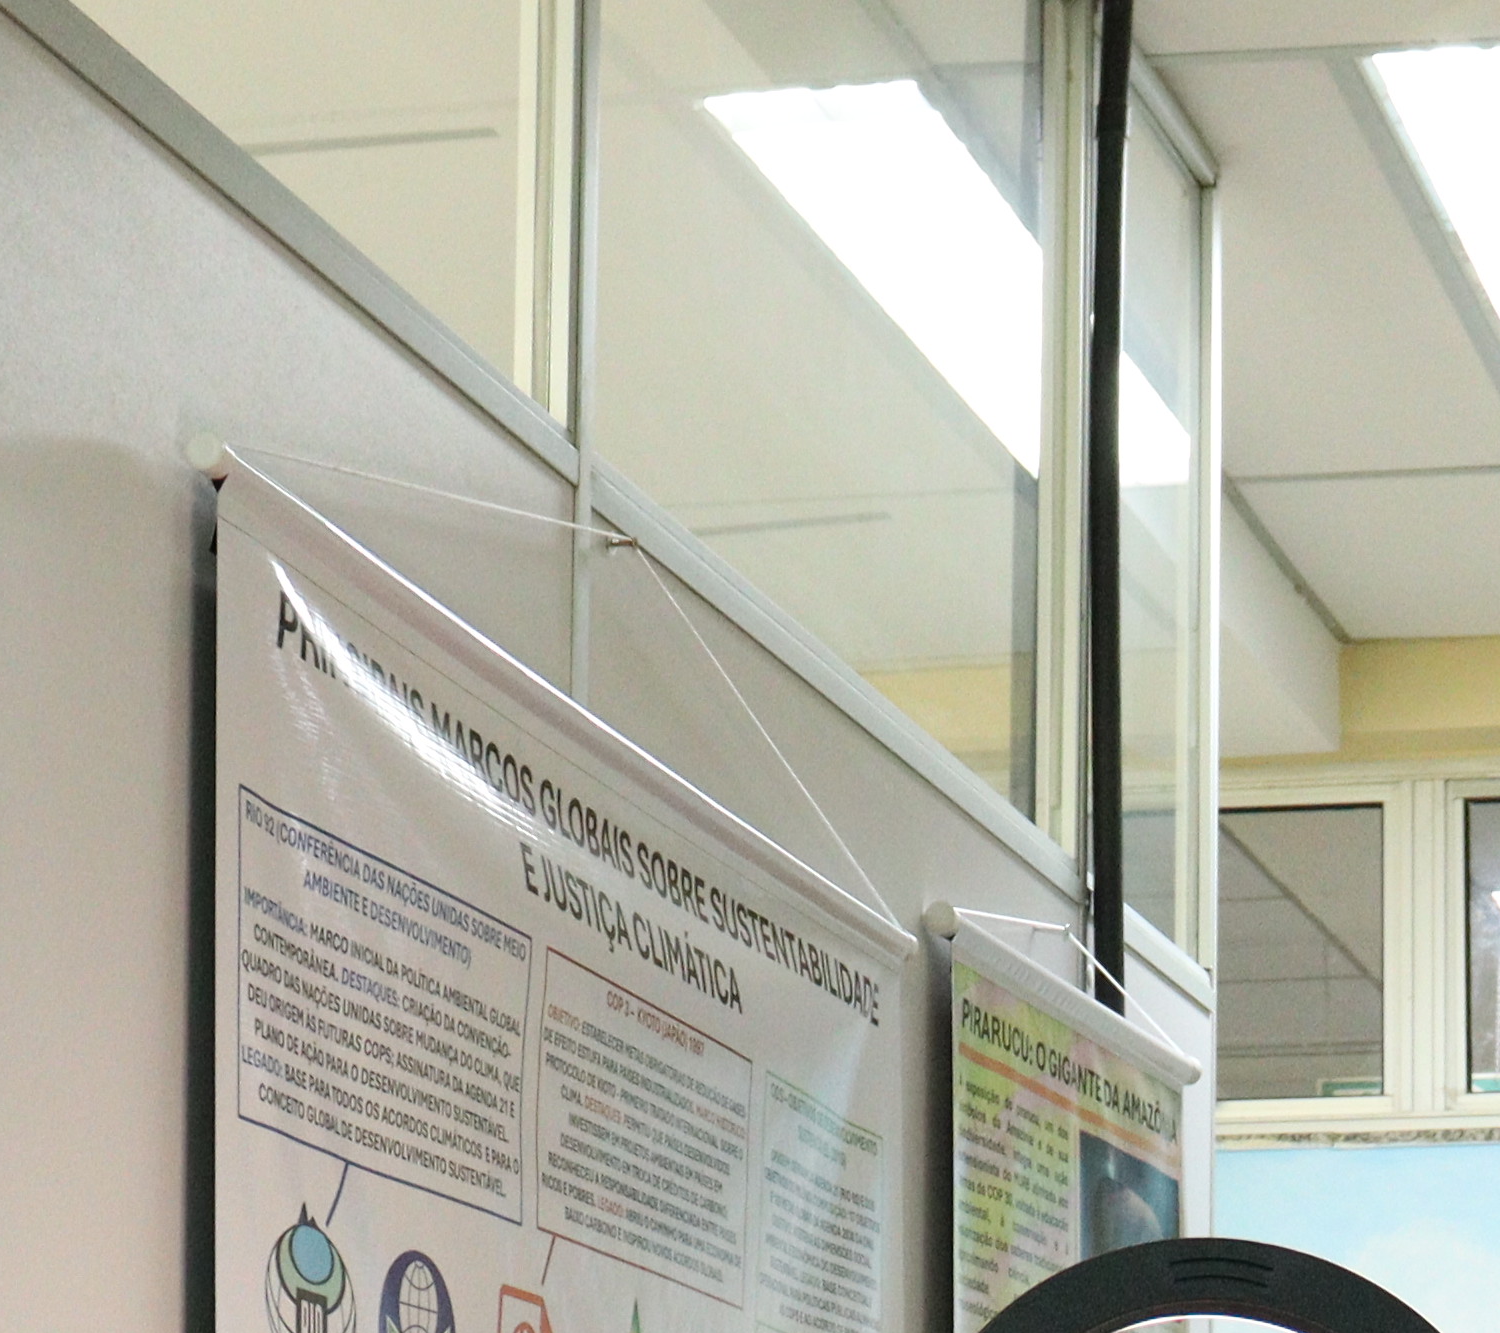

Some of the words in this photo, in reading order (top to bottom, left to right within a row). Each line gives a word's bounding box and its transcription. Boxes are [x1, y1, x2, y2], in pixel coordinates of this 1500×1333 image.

[245, 799, 264, 829] RIO
[265, 811, 274, 835] 92
[275, 817, 360, 879] (CONFERÊNCIA
[362, 860, 384, 890] DAS
[386, 872, 429, 914] NAÇÕES
[431, 896, 469, 933] UNIDAS
[471, 916, 501, 949] SOBRE
[503, 933, 525, 962] MEIO
[303, 867, 360, 914] AMBIENTE
[362, 896, 369, 918] E
[371, 899, 471, 969] DESENVOLVIMENTO)
[430, 701, 536, 818] MARCOS
[539, 774, 634, 880] GLOBAIS
[637, 838, 708, 925] SOBRE
[710, 882, 878, 1027] SUSTENTABILIDADE
[520, 842, 539, 896] E
[542, 853, 630, 952] JUSTIÇA
[631, 906, 743, 1013] CLIMÁTICA
[242, 950, 281, 986] QUADRO
[283, 970, 300, 994] DAS
[302, 978, 340, 1013] NAÇÕES
[342, 997, 381, 1031] UNIDAS
[383, 1015, 413, 1045] SOBRE
[415, 1030, 458, 1064] MUDANÇA
[460, 1050, 472, 1071] DO
[474, 1057, 502, 1086] CLIMA,
[503, 1070, 520, 1093] QUE
[243, 887, 307, 935] IMPORTÂNCIA:
[309, 921, 348, 956] MARCO
[350, 941, 384, 972] INICIAL
[386, 958, 398, 979] DA
[401, 964, 440, 998] POLÍTICA
[442, 984, 487, 1020] AMBIENTAL
[489, 1007, 521, 1036] GLOBAL
[253, 923, 338, 981] CONTEMPORÂNEA.
[341, 966, 400, 1009] DESTAQUES:
[402, 994, 441, 1028] CRIAÇÃO
[443, 1014, 455, 1034] DA
[457, 1020, 510, 1059] CONVENÇÃO-
[241, 1044, 282, 1079] LEGADO:
[284, 1063, 307, 1090] BASE
[309, 1073, 330, 1100] PARA
[330, 1084, 363, 1114] TODOS
[365, 1099, 380, 1120] OS
[381, 1105, 428, 1140] ACORDOS
[430, 1124, 482, 1161] CLIMÁTICOS
[485, 1147, 490, 1164] E
[491, 1149, 511, 1173] PARA
[512, 1158, 518, 1176] O
[247, 983, 267, 1009] DEU
[269, 992, 303, 1025] ORIGEM
[317, 1016, 361, 1053] FUTURAS
[396, 1050, 450, 1091] ASSINATURA
[452, 1075, 463, 1096] DA
[465, 1080, 497, 1111] AGENDA
[498, 1096, 508, 1116] 21
[509, 1100, 514, 1118] E
[255, 1019, 284, 1049] PLANO
[286, 1032, 299, 1056] DE
[301, 1039, 324, 1068] AÇÃO
[326, 1051, 348, 1078] PARA
[351, 1062, 358, 1082] O
[361, 1065, 450, 1121] DESENVOLVIMENTO
[452, 1104, 509, 1143] SUSTENTÁVEL.
[962, 997, 1033, 1066] PIRARUCU:
[1036, 1040, 1045, 1072] O
[1049, 1047, 1101, 1103] GIGANTE
[1104, 1078, 1118, 1111] DA
[1123, 1088, 1176, 1144] AMAZÔA
[258, 1082, 304, 1120] CONCEITO
[307, 1104, 340, 1135] GLOBAL
[340, 1119, 352, 1141] DE
[355, 1122, 446, 1178] DESENVOLVIMENTO
[448, 1159, 507, 1199] SUSTENTÁVEL.
